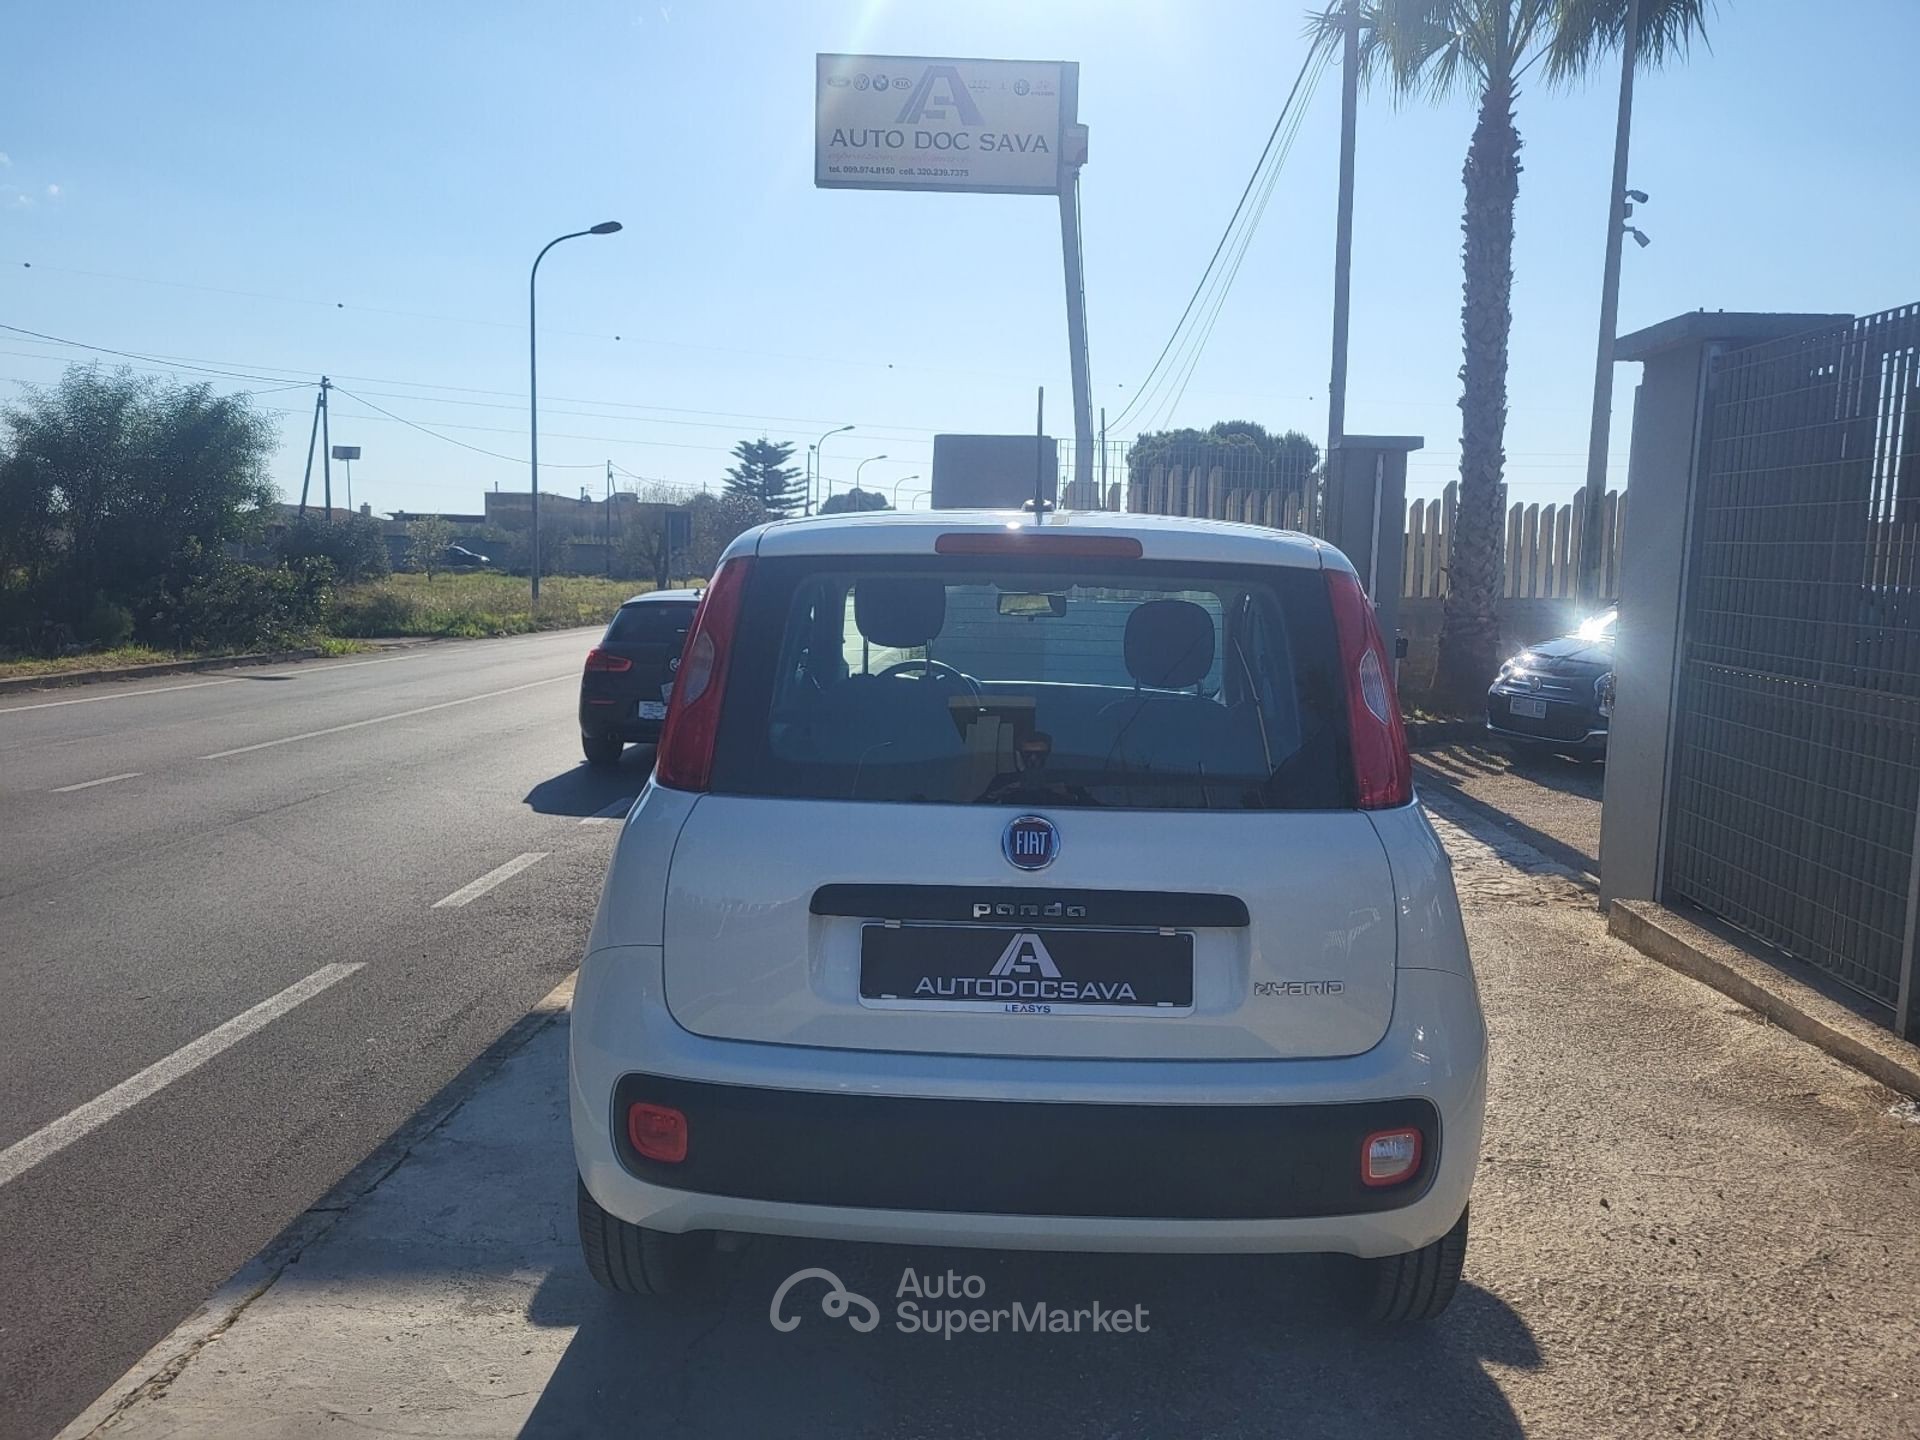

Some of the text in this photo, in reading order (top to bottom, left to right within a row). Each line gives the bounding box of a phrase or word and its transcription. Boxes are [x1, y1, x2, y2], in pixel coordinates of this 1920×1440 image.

[829, 128, 1049, 153] AUTO DOC SAVA
[828, 166, 842, 175] tel.
[899, 167, 916, 176] cell.
[1015, 829, 1046, 856] FIAT
[973, 902, 1087, 918] panda
[914, 976, 1138, 1002] AUTODOCSAVA
[1254, 980, 1345, 997] HYBRID
[1004, 1003, 1051, 1015] LEASYS
